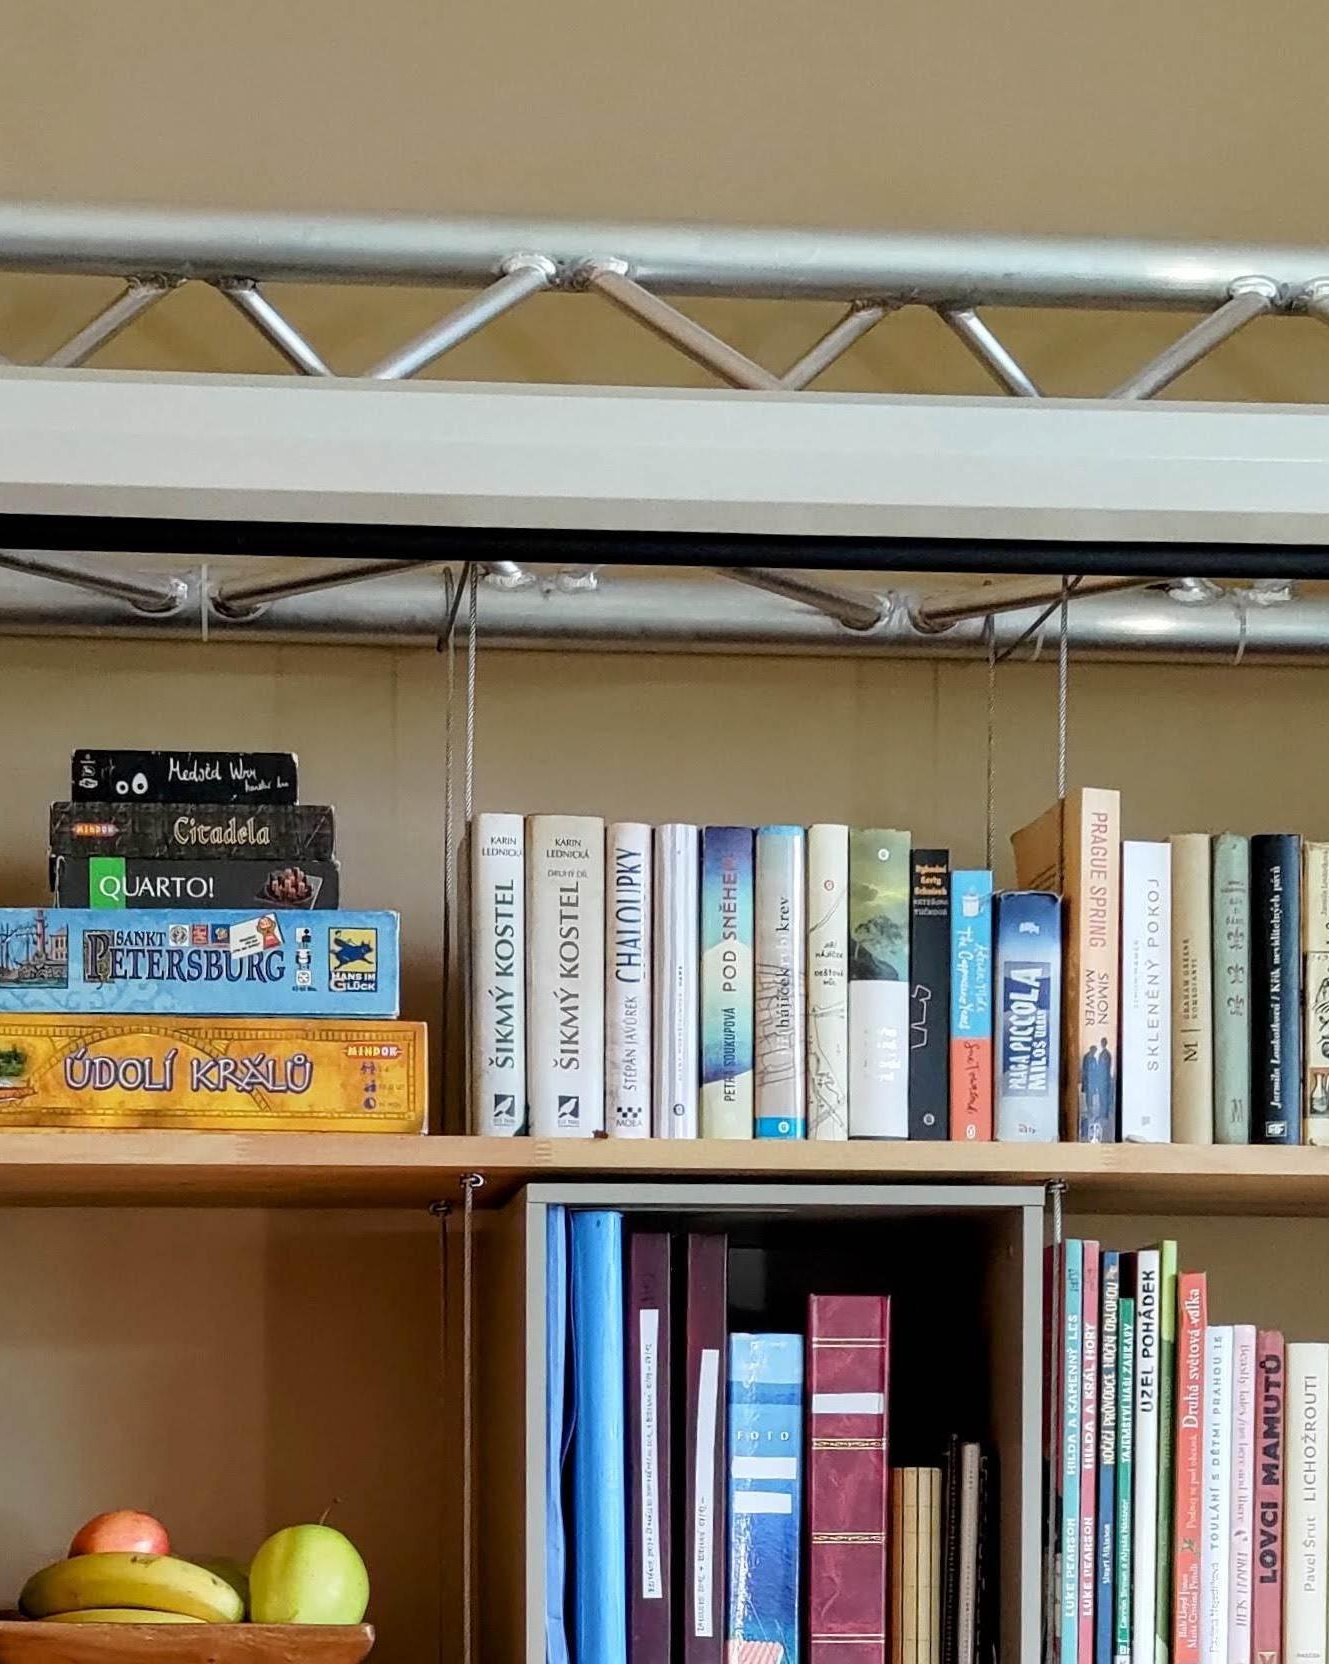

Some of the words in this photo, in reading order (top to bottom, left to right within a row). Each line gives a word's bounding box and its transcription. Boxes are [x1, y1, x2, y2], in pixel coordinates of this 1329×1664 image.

[173, 816, 270, 846] Citadela
[555, 837, 582, 847] KARIN
[1090, 813, 1108, 879] PRAGUE
[99, 876, 214, 900] QUARTO!
[1147, 878, 1160, 948] POKOJ
[114, 931, 166, 947] SANKT
[495, 879, 515, 977] KOSTEL
[560, 881, 580, 979] KOSTEL
[615, 847, 642, 983] CHALOUPKY
[775, 897, 790, 932] krev
[1089, 886, 1107, 948] SPRING
[86, 934, 286, 984] PETERSBURG
[331, 970, 361, 982] HANS
[363, 973, 376, 981] IM
[723, 951, 737, 992] POD
[330, 980, 375, 992] GLÜCK
[1008, 967, 1043, 1051] PICCOLA
[1085, 969, 1095, 1026] MAWER
[1097, 972, 1110, 1025] SIMON
[488, 985, 515, 1069] ŠIKMÝ
[553, 987, 580, 1070] ŠIKMÝ
[721, 1008, 736, 1067] SOUKUPOVÁ
[1145, 958, 1160, 1072] SKLENĚNÝ
[64, 1047, 179, 1092] ÚDOLÍ
[190, 1052, 314, 1094] KRÁLŮ
[347, 1046, 399, 1057] MINDOK
[1068, 1314, 1078, 1341] LES
[1138, 1269, 1155, 1359] POHÁDEK
[1084, 1322, 1095, 1361] HORY
[1184, 1328, 1200, 1381] světová
[1066, 1347, 1078, 1414] KAMENNÝ
[1083, 1362, 1095, 1400] KRÁL
[1141, 1365, 1154, 1413] UZEL
[1211, 1356, 1222, 1415] PRAHOU
[1181, 1384, 1199, 1429] Druhá
[1259, 1354, 1281, 1486] MAMUTŮ
[1067, 1433, 1077, 1475] HILDA
[1084, 1420, 1094, 1470] HILDA
[1210, 1422, 1221, 1466] DĚTMI
[1301, 1375, 1317, 1502] LICHOŽROUTI
[1209, 1487, 1220, 1551] TOULÁNÍ
[1259, 1501, 1279, 1584] LOVCI
[1302, 1516, 1316, 1548] Šrut
[1065, 1517, 1076, 1579] PEARSON
[1083, 1516, 1093, 1578] PEARSON
[1304, 1553, 1316, 1592] Pavel
[1065, 1583, 1075, 1618] LUKE
[1083, 1582, 1093, 1617] LUKE
